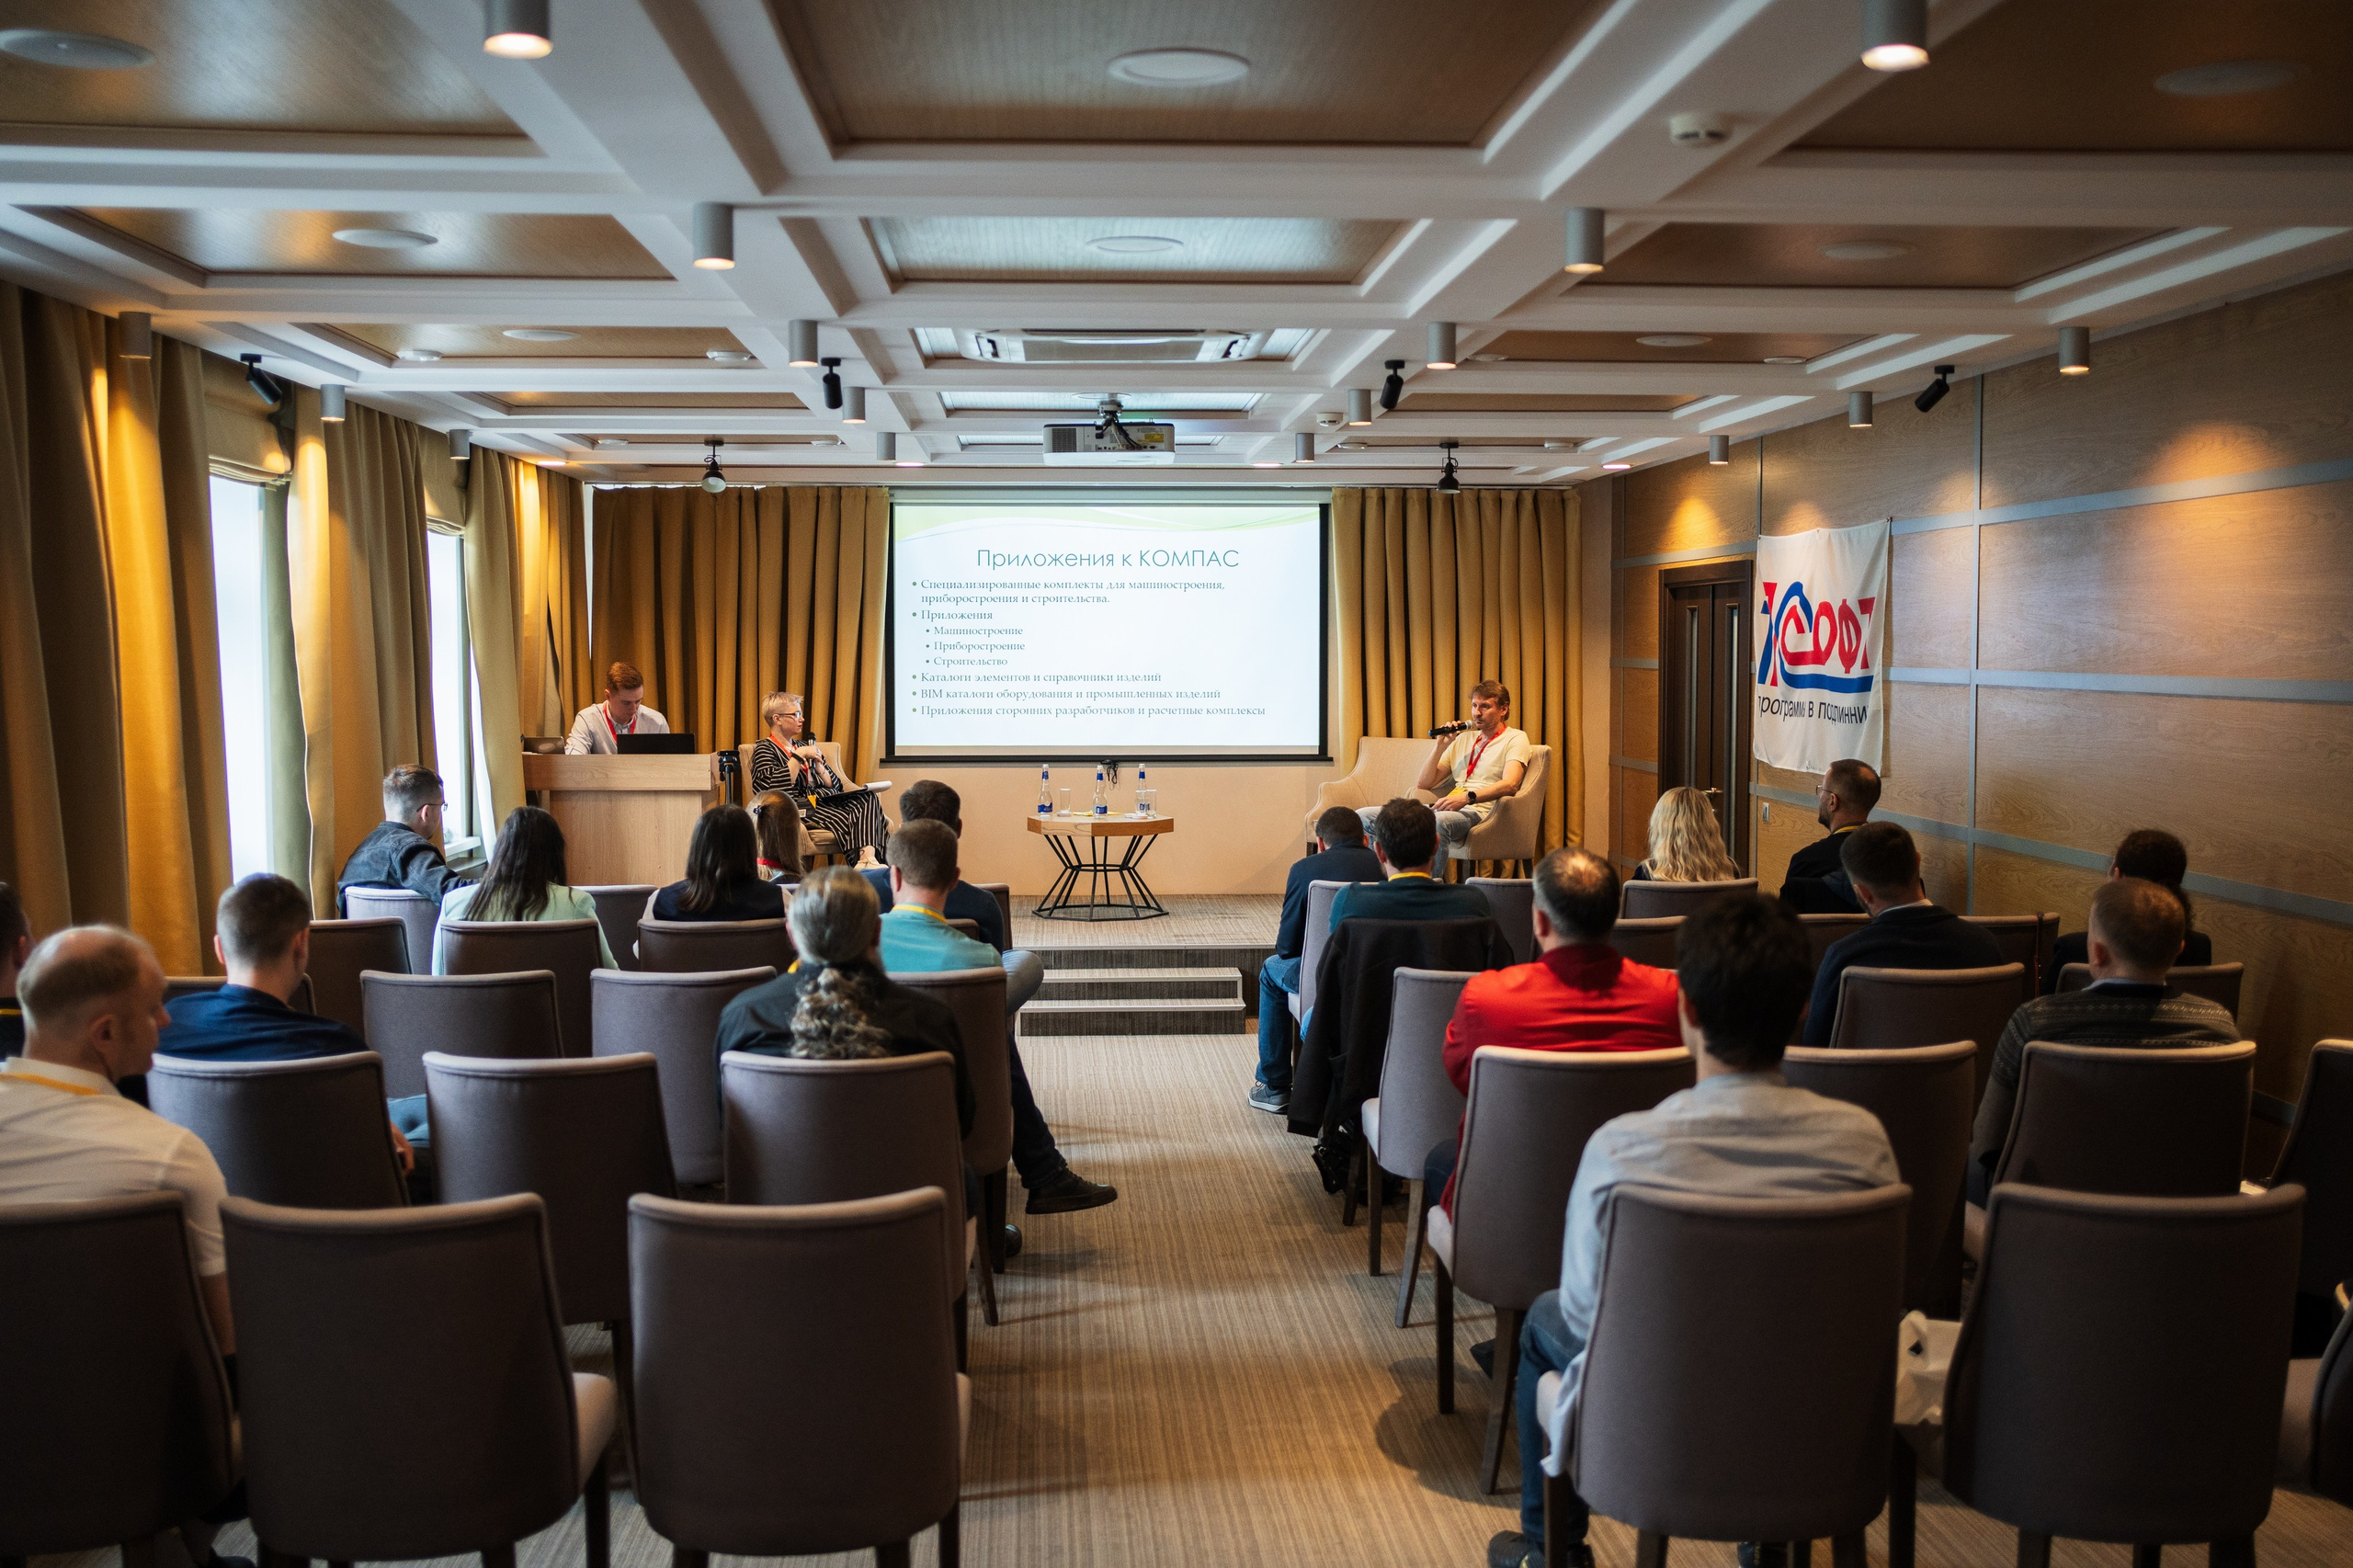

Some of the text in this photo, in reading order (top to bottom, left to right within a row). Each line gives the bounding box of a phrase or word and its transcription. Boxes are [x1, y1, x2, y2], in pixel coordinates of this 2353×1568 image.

[978, 550, 1239, 571] Приложения к КОМПАС
[921, 579, 1040, 592] Специализированные
[1107, 582, 1126, 590] для
[1129, 582, 1225, 592] машиностроения,
[921, 594, 1018, 606] приборостроения
[1031, 596, 1110, 606] строительства.
[921, 609, 993, 622] Приложения
[934, 626, 1023, 638] Машиностроение
[934, 641, 1026, 653] Приборостроение
[933, 656, 1008, 668] Строительство
[921, 672, 972, 682] Каталоги
[1043, 675, 1113, 685] справочники
[1117, 672, 1162, 683] изделий
[996, 688, 1073, 701] оборудования
[1086, 691, 1173, 701] промышленных
[1176, 689, 1221, 699] изделий
[921, 705, 993, 718] Приложения
[1055, 705, 1135, 718] разработчиков
[1148, 708, 1203, 718] расчетные
[1808, 701, 1814, 717] в
[1818, 701, 1870, 725] подлинни
